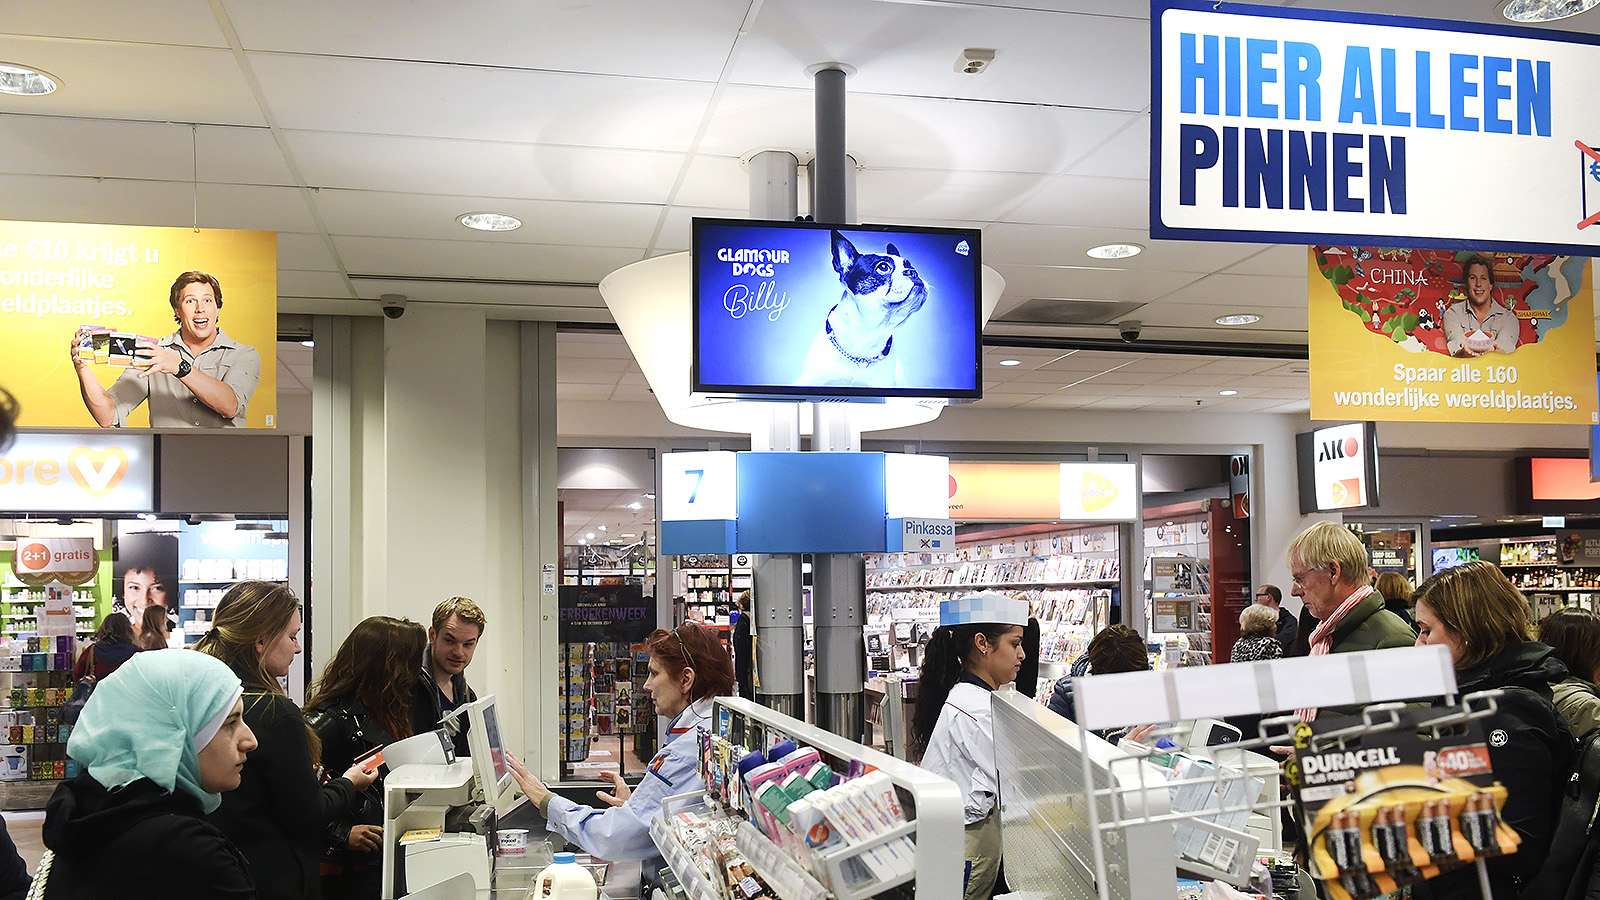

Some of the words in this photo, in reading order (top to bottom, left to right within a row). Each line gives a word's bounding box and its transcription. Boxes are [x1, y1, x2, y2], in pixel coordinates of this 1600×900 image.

[1179, 32, 1322, 122] HIER
[1338, 45, 1552, 138] ALLEEN
[1179, 123, 1407, 215] PINNEN
[26, 240, 70, 261] €10
[76, 240, 138, 267] krijgt
[145, 247, 160, 264] u
[717, 247, 790, 264] GLAMOUR
[1369, 268, 1429, 286] CHINA
[0, 293, 133, 320] eldplaatjes.
[723, 280, 791, 322] Billy
[1393, 362, 1447, 386] Spaar
[1450, 365, 1482, 383] alle
[1486, 365, 1518, 384] 160
[1334, 389, 1440, 411] wonderlijke
[1445, 391, 1579, 414] wereldplaatjes.
[1319, 437, 1359, 462] AKO
[685, 469, 704, 504] 7
[905, 521, 953, 538] Pinkassa
[24, 551, 47, 561] 2+1
[54, 550, 90, 562] gratis
[1302, 747, 1400, 774] DURACELL
